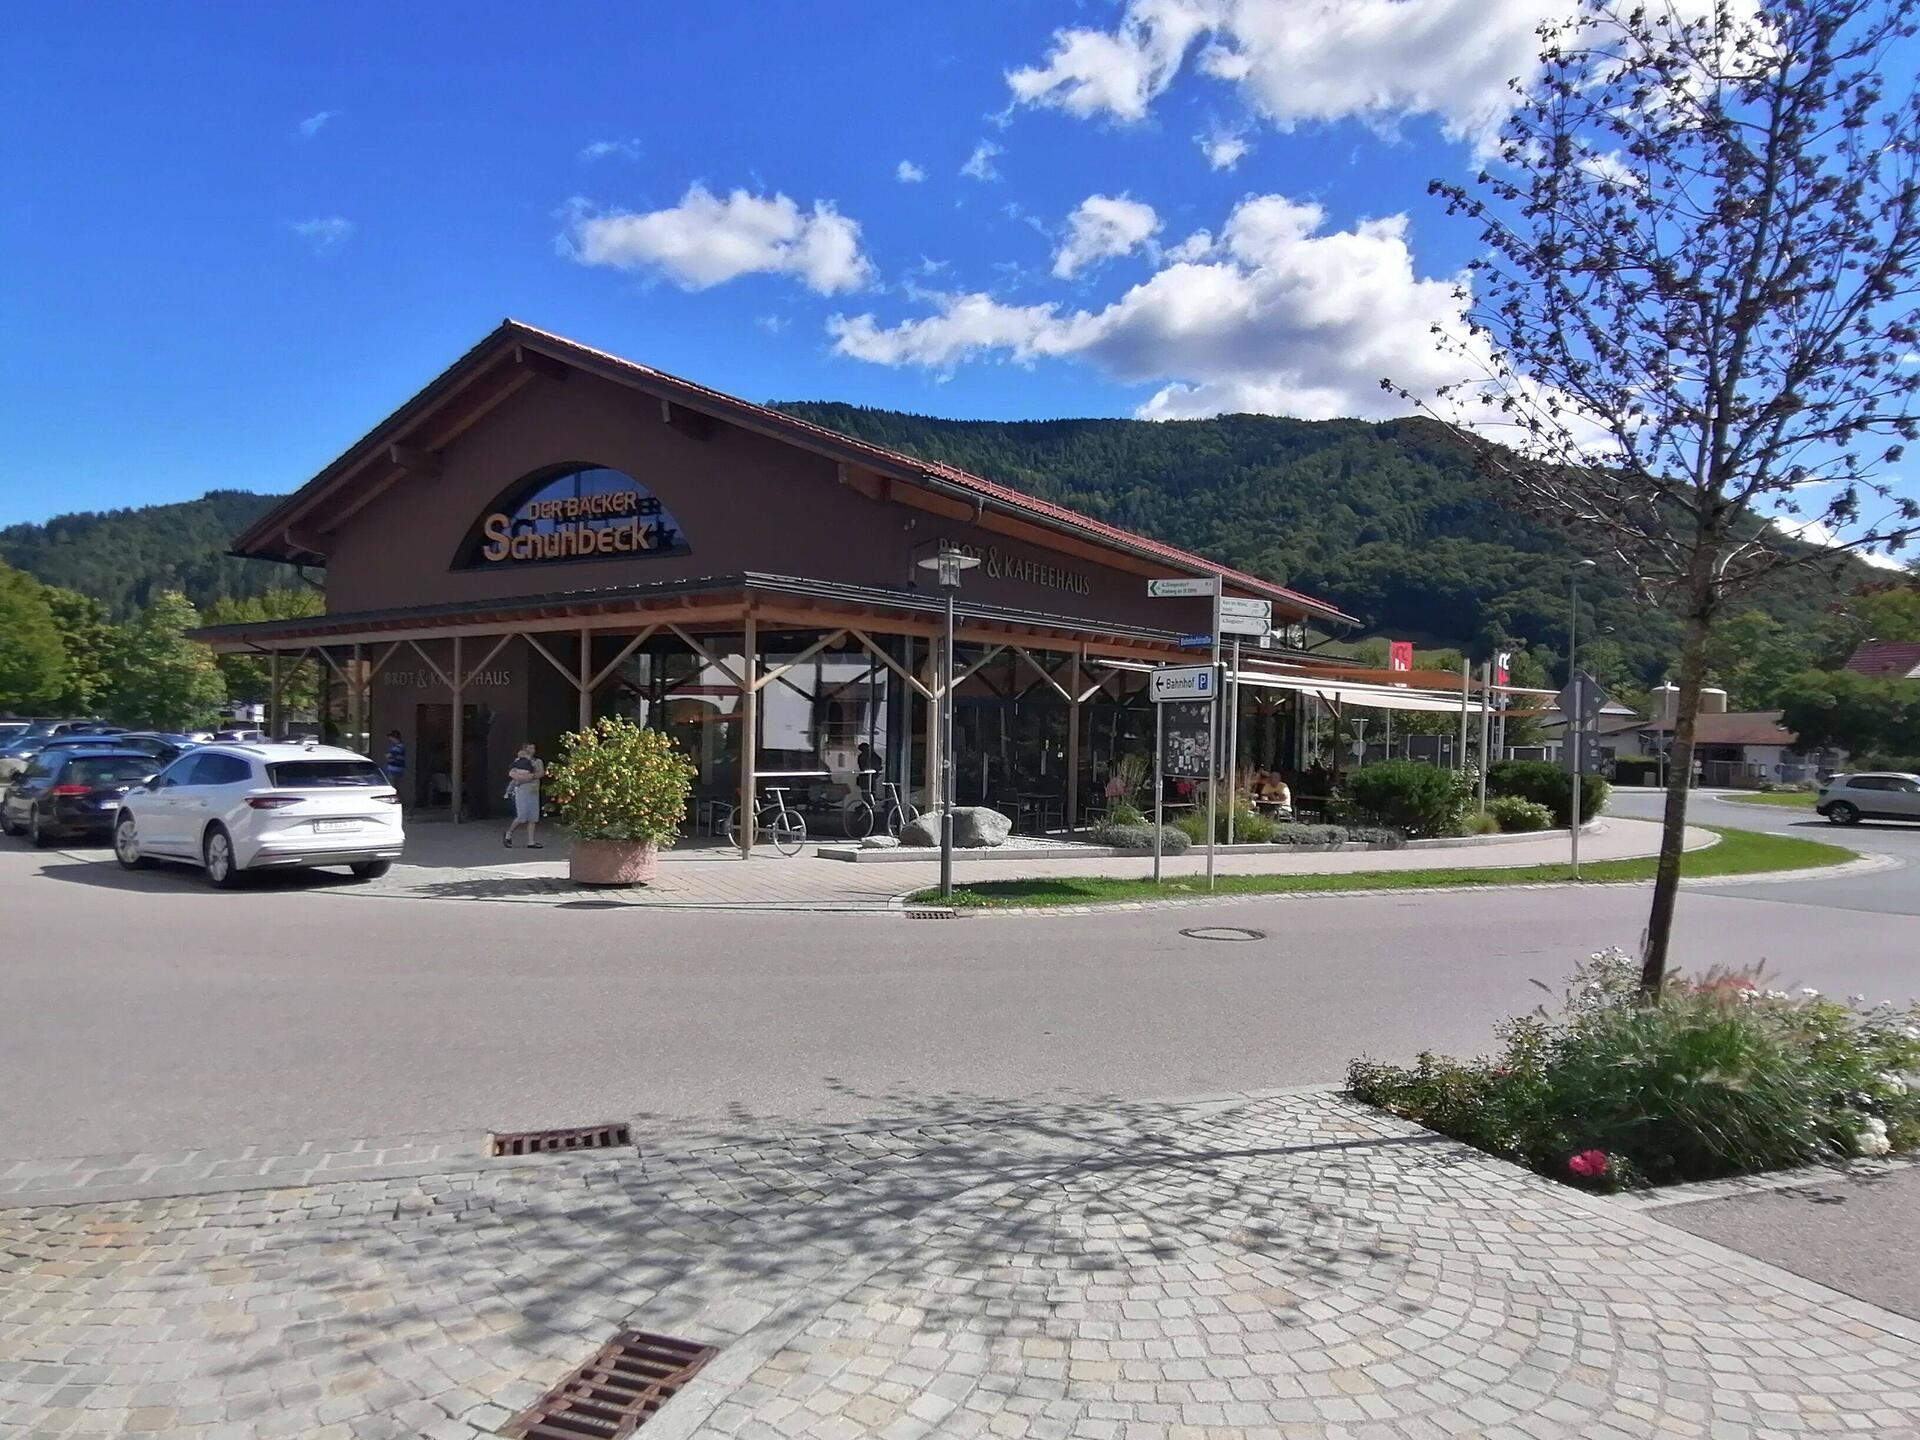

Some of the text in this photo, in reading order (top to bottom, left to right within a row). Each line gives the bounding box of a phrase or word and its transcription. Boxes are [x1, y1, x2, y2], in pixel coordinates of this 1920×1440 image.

[528, 501, 562, 520] DER
[987, 545, 1001, 580] &
[1004, 554, 1091, 596] KAFFEEHAUS
[1166, 676, 1195, 690] Bahnhof
